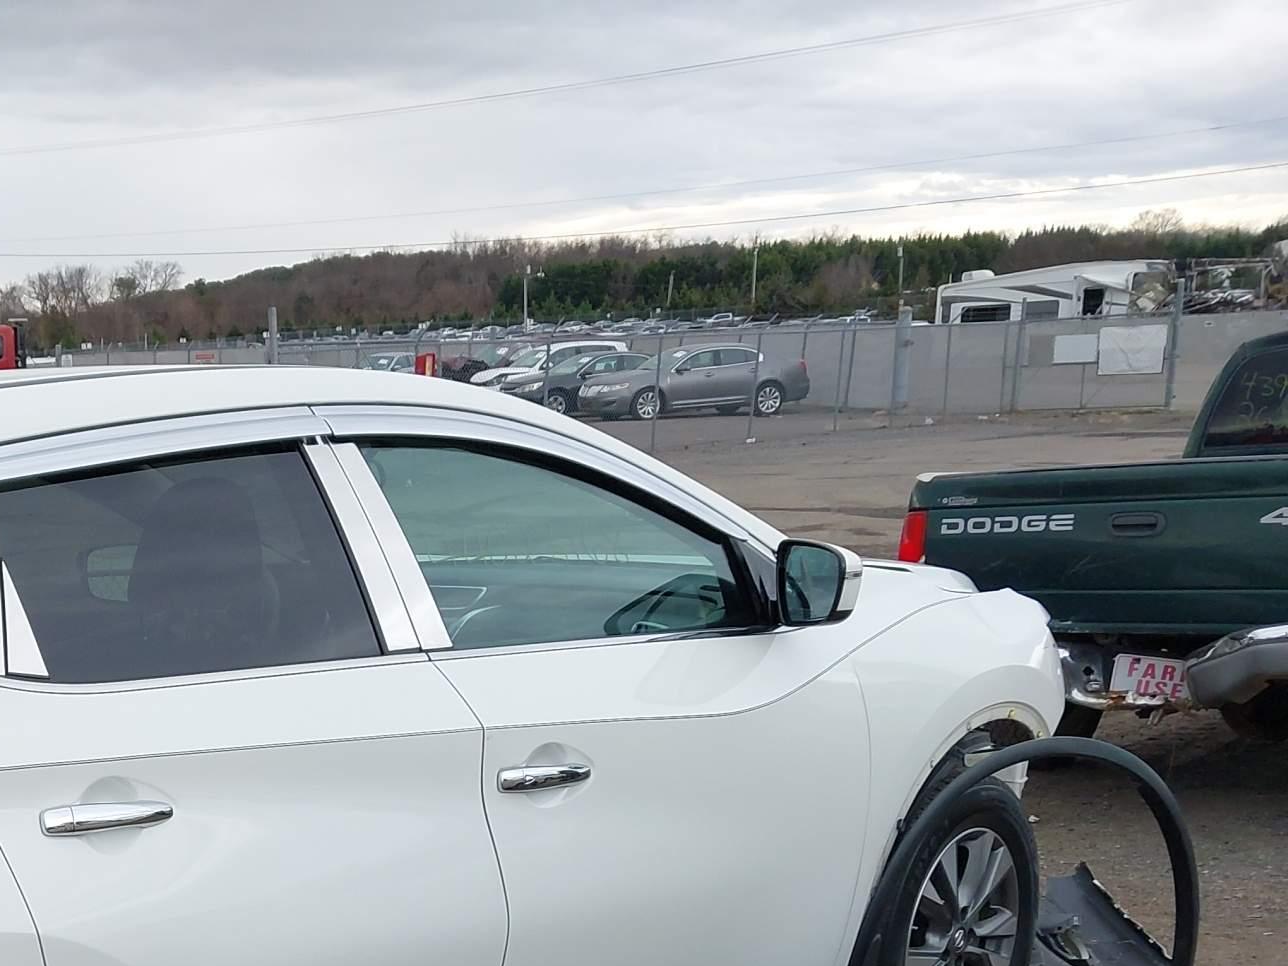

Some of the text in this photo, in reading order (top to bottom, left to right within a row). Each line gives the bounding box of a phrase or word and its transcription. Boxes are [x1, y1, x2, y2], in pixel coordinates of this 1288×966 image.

[940, 513, 1075, 535] DODGE
[1127, 657, 1188, 682] FAR
[1135, 679, 1185, 699] USE
